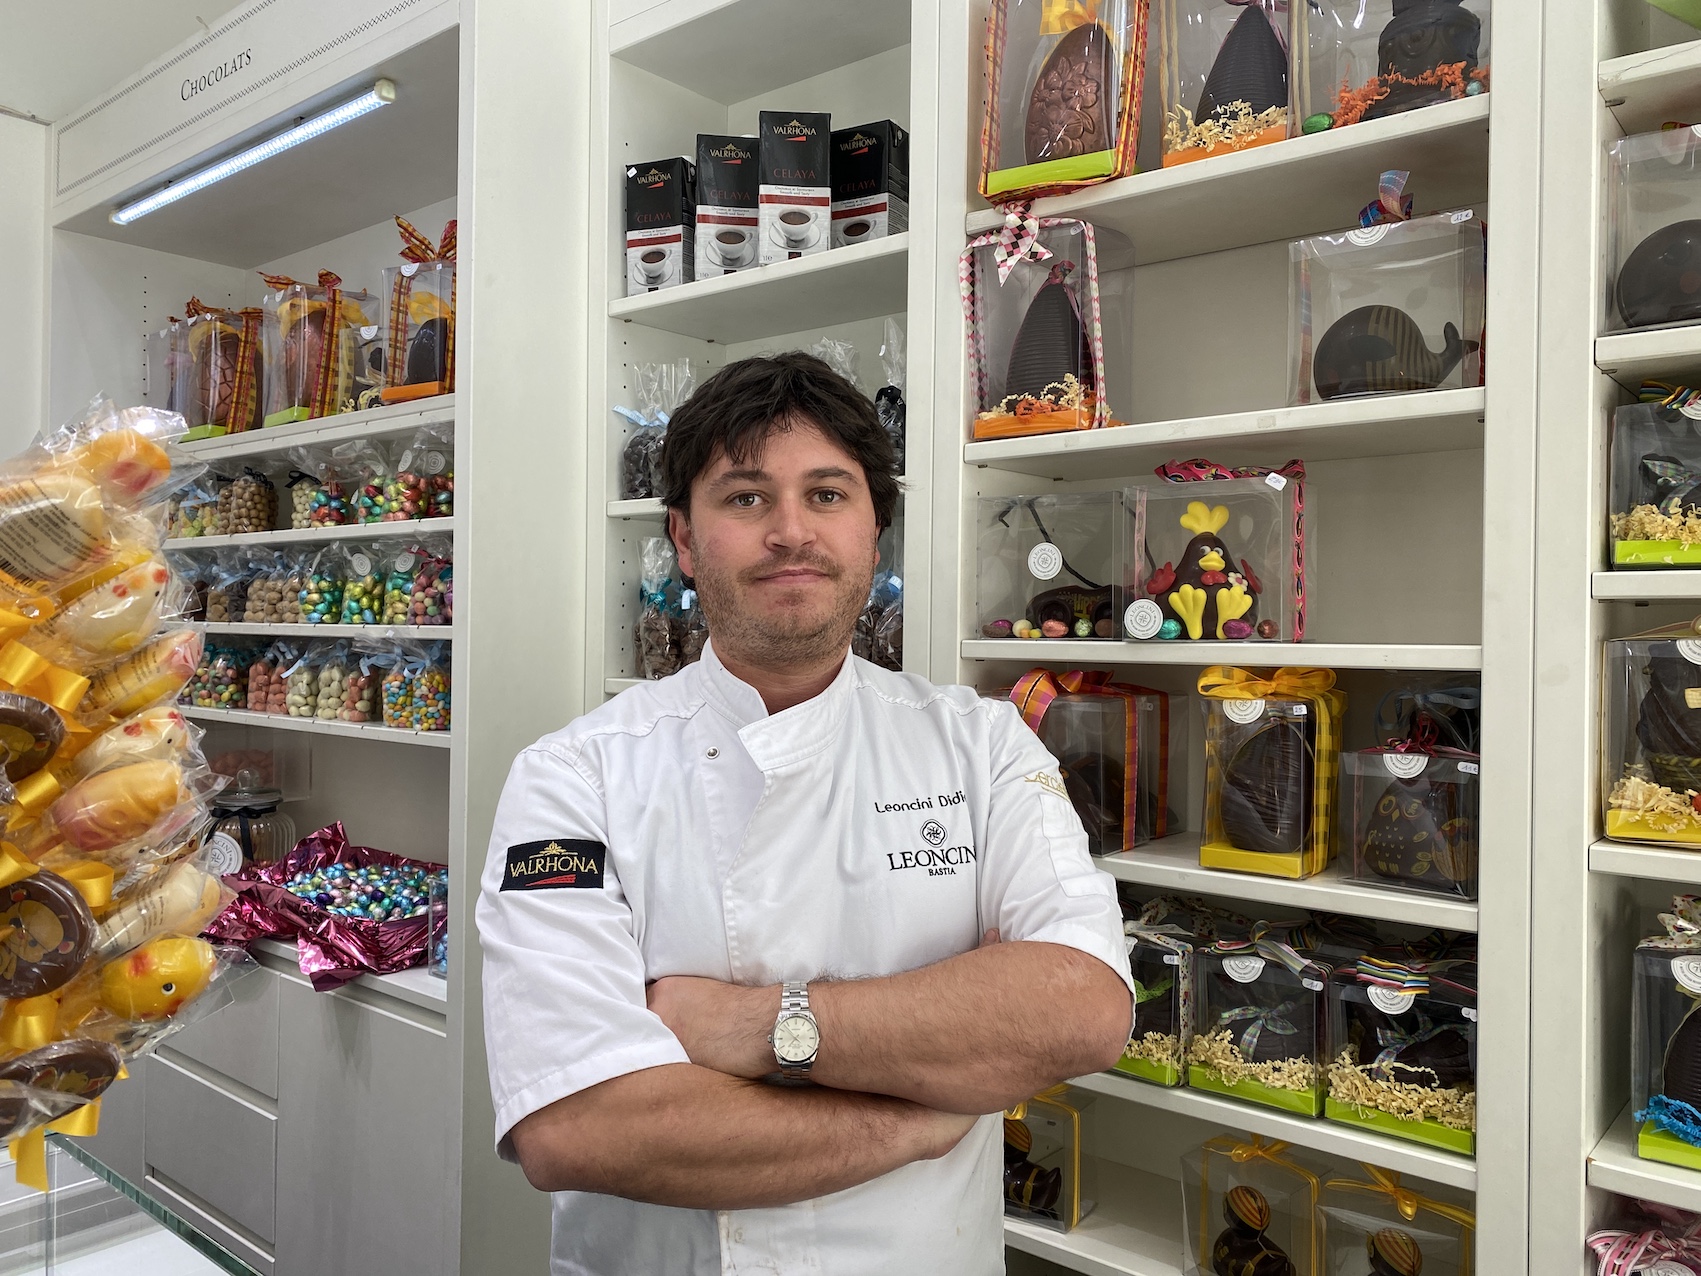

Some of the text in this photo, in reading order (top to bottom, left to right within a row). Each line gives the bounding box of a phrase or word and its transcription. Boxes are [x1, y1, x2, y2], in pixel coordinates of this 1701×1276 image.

[773, 126, 817, 136] VALRHONA
[839, 138, 877, 151] VALRHONA
[709, 148, 752, 159] VALRHONA
[636, 173, 672, 184] VALRHONA
[773, 168, 816, 179] CELAYA
[839, 179, 876, 194] CELAYA
[709, 189, 751, 201] CELAYA
[636, 211, 672, 223] CELAYA
[874, 788, 967, 814] Leoncini Didi
[886, 845, 978, 872] LEONCIN
[510, 856, 599, 878] VALRHONA
[928, 867, 957, 877] BASTIA
